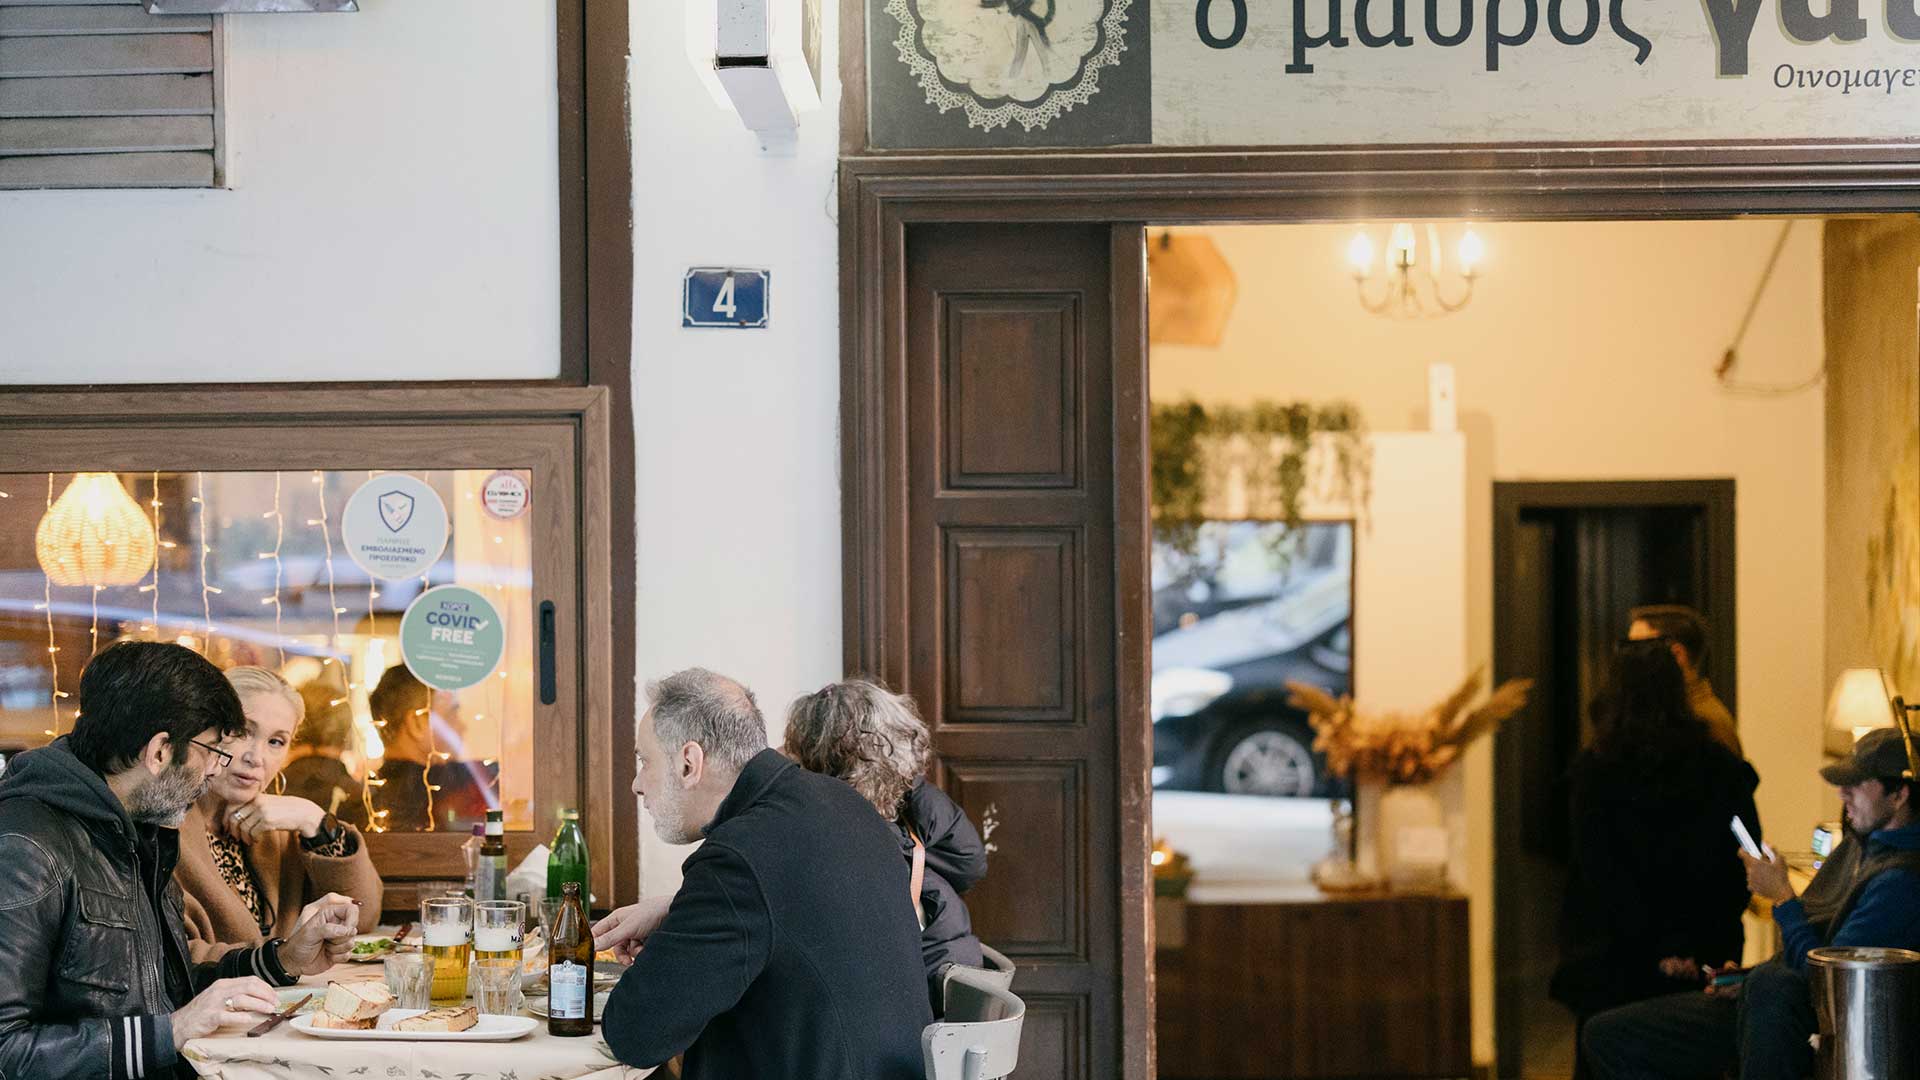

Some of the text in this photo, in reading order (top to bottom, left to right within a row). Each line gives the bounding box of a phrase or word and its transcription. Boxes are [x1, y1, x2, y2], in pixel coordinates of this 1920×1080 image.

[1773, 63, 1920, 94] Οινομαγε
[713, 276, 737, 318] 4
[361, 544, 426, 556] ΕΜΒΟΛΙΑΣΜΕΝΟ
[426, 611, 481, 630] COVID
[431, 626, 475, 645] FREE
